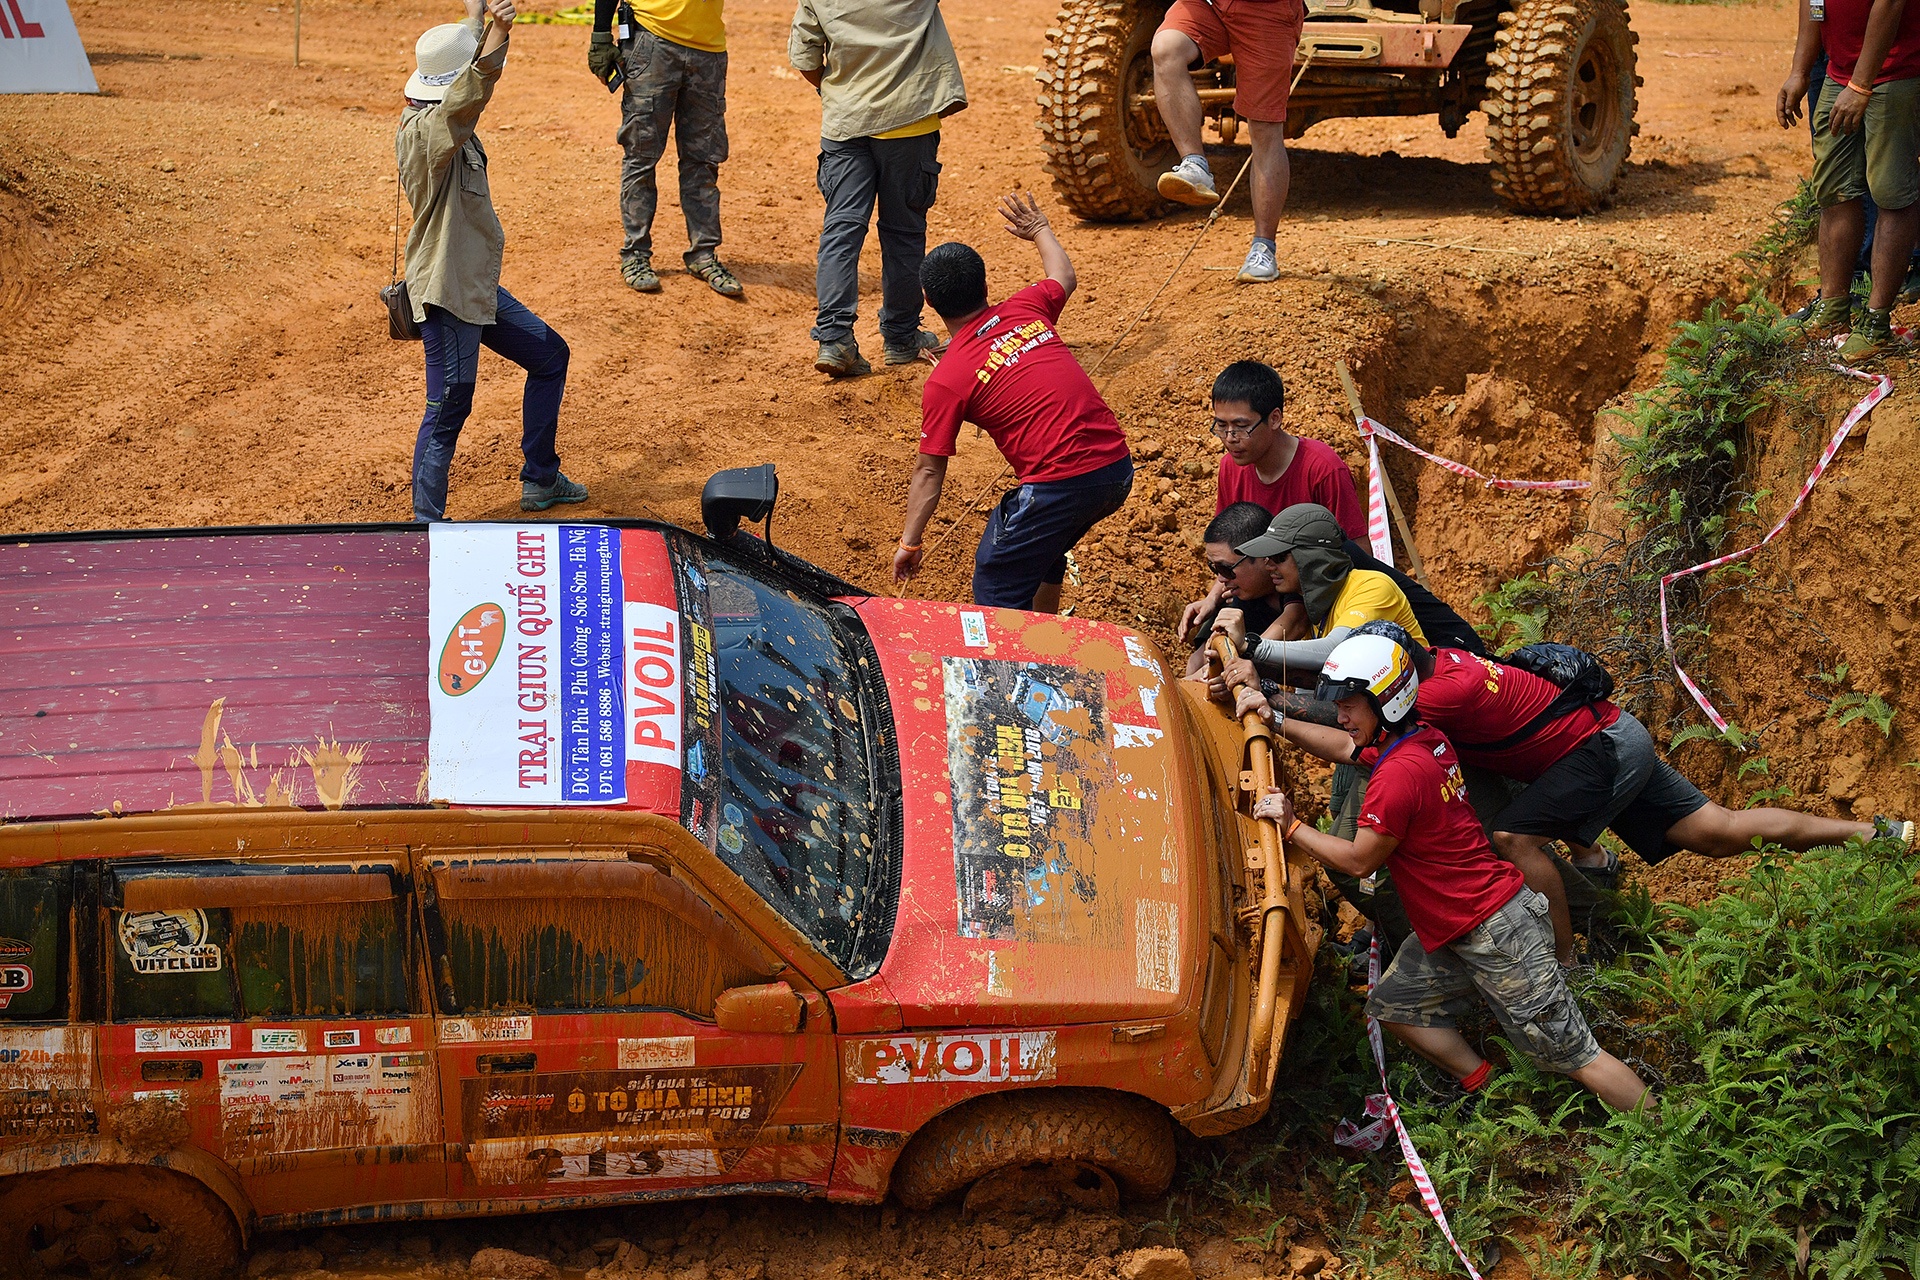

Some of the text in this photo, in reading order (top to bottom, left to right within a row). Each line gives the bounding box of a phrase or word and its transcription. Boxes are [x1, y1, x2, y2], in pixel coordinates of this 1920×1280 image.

[568, 547, 587, 563] Hà
[569, 571, 588, 594] Sơn
[569, 595, 588, 617] Sóc
[458, 625, 487, 676] GHT
[570, 626, 592, 667] Cường
[697, 627, 706, 650] 213
[504, 530, 555, 788] TRẠI GIUN QUẾ GHT
[597, 632, 612, 679] Website
[570, 671, 589, 696] Phú
[633, 620, 676, 751] PVOIL
[1371, 665, 1390, 681] PVOIL
[598, 689, 612, 717] 8886
[571, 706, 590, 734] Phú
[598, 720, 612, 742] 586
[572, 737, 590, 764] Tân
[1024, 727, 1043, 761] 2018
[599, 746, 613, 768] 081
[571, 768, 590, 794] ĐC:
[600, 769, 613, 794] ĐT:
[996, 843, 1031, 858] Ô
[136, 956, 218, 971] VITCLUB
[169, 1029, 227, 1041] NO QUALITY
[261, 1033, 298, 1043] VETC
[869, 1037, 1036, 1079] PVOIL
[366, 1086, 411, 1095] Autonet
[567, 1085, 587, 1113] Ô
[593, 1085, 628, 1111] TÔ
[710, 1107, 752, 1121] 2018
